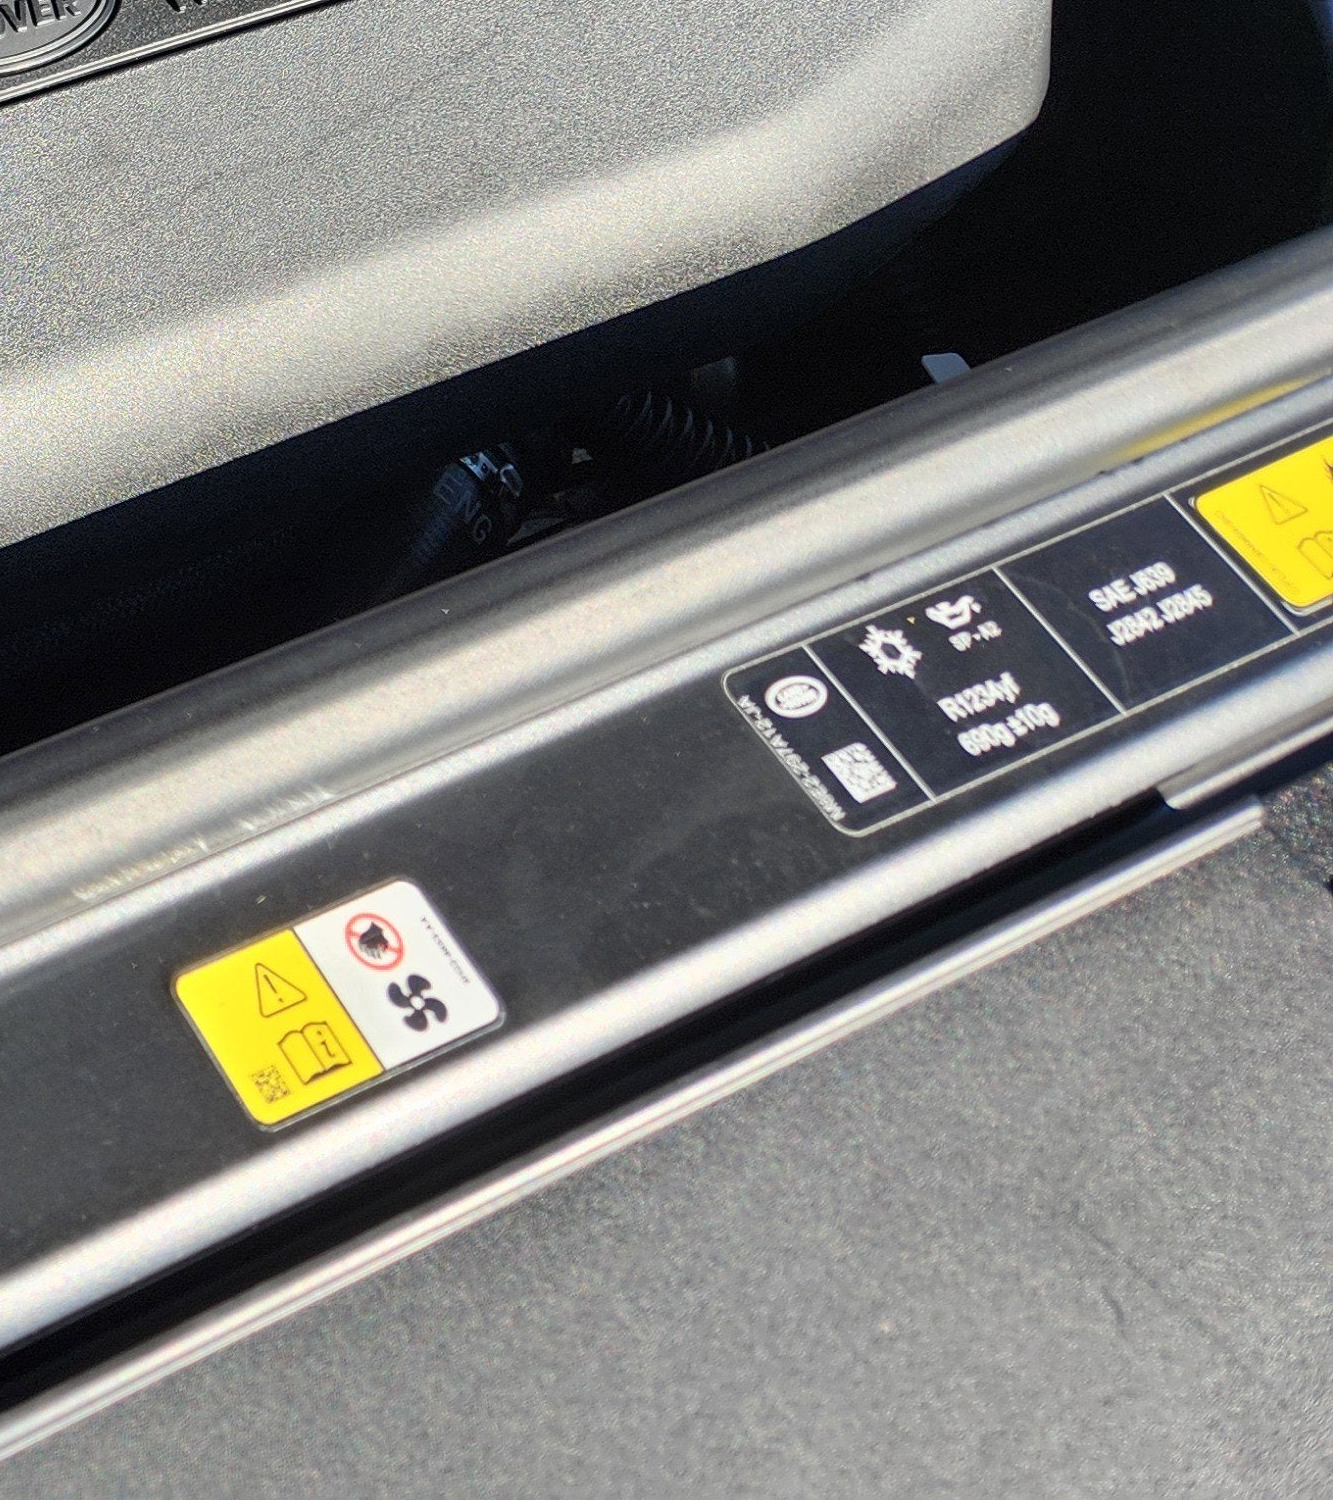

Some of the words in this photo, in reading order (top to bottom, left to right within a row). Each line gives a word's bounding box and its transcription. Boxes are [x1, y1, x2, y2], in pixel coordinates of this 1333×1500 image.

[1088, 579, 1137, 612] SAE
[1129, 562, 1176, 596] J639
[1106, 607, 1164, 646] J2842
[1156, 584, 1213, 623] J2845
[937, 671, 1021, 723] R1234yf
